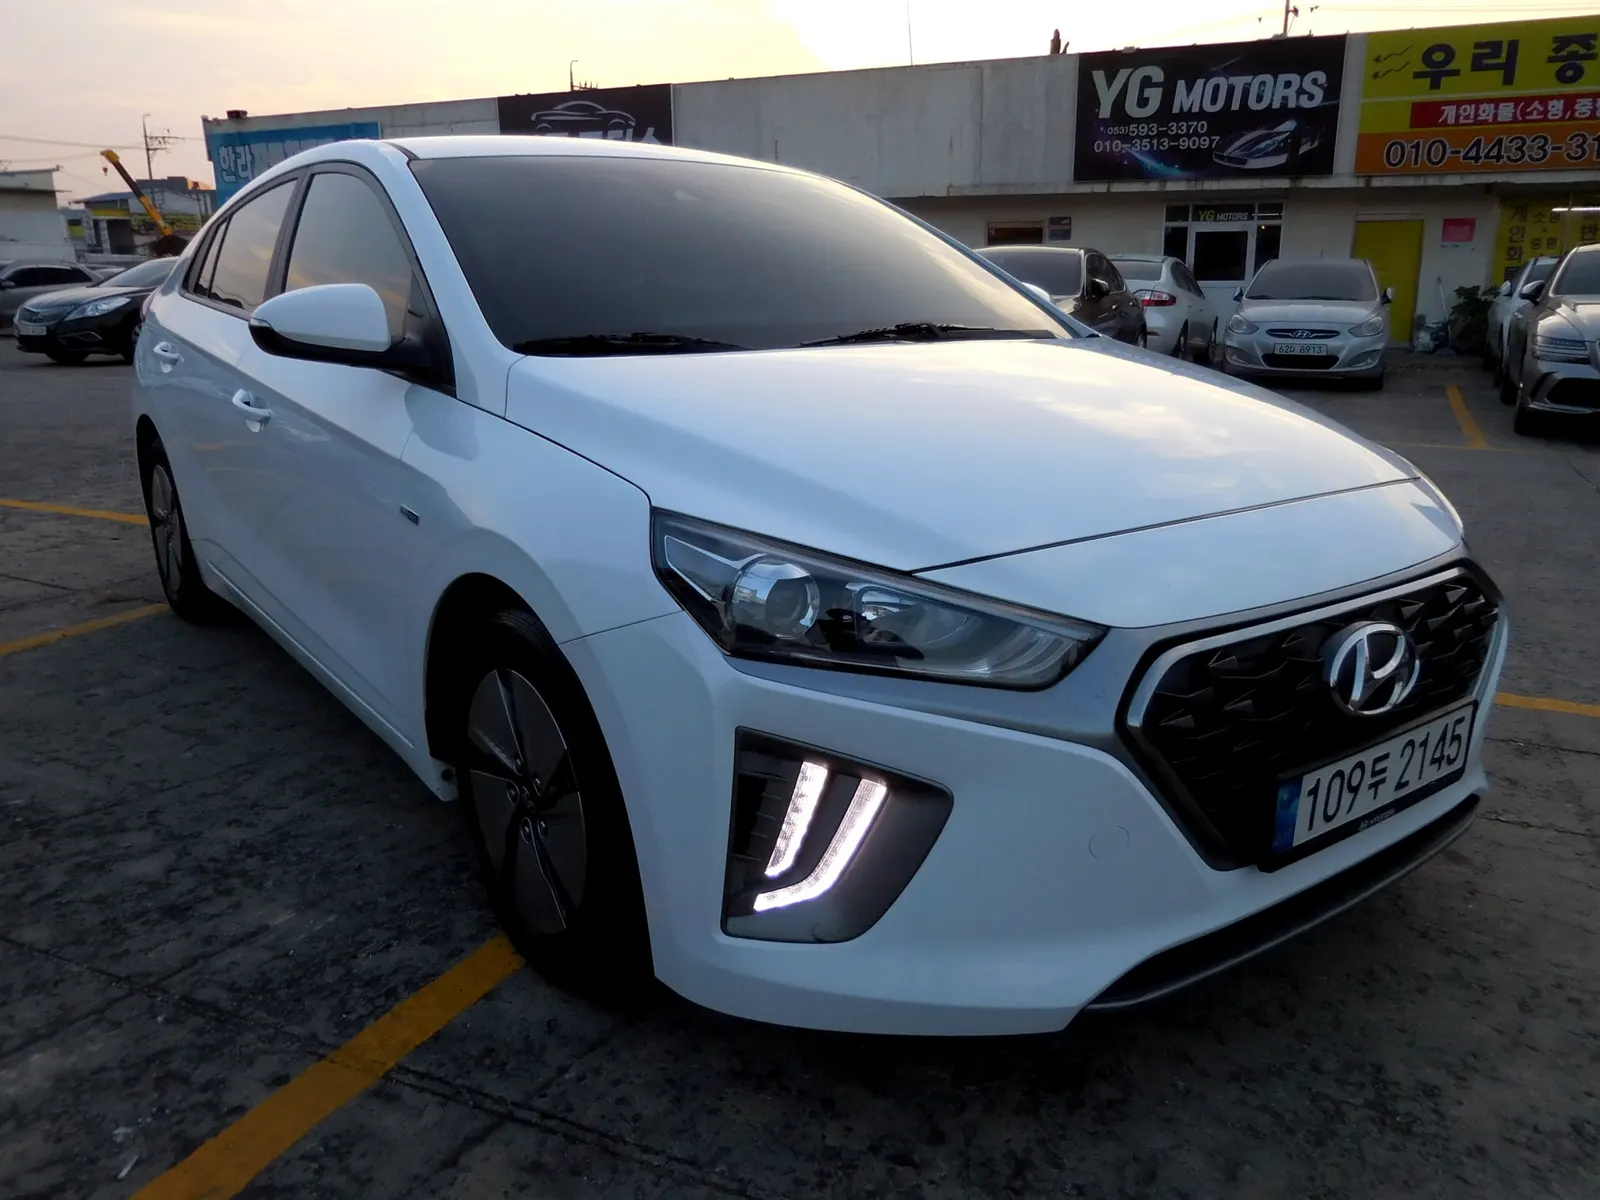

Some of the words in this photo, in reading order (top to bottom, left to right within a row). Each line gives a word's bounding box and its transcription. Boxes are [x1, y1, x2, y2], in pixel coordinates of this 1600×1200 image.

[1413, 39, 1520, 90] 우리
[1092, 65, 1164, 119] YG
[1172, 70, 1327, 114] MOTORS
[1094, 136, 1220, 153] 010-3513-9097
[1197, 208, 1216, 221] YG
[1216, 212, 1249, 221] MOTORS
[1299, 345, 1322, 354] 8913
[1306, 751, 1391, 832] 109두
[1394, 715, 1466, 793] 2145
